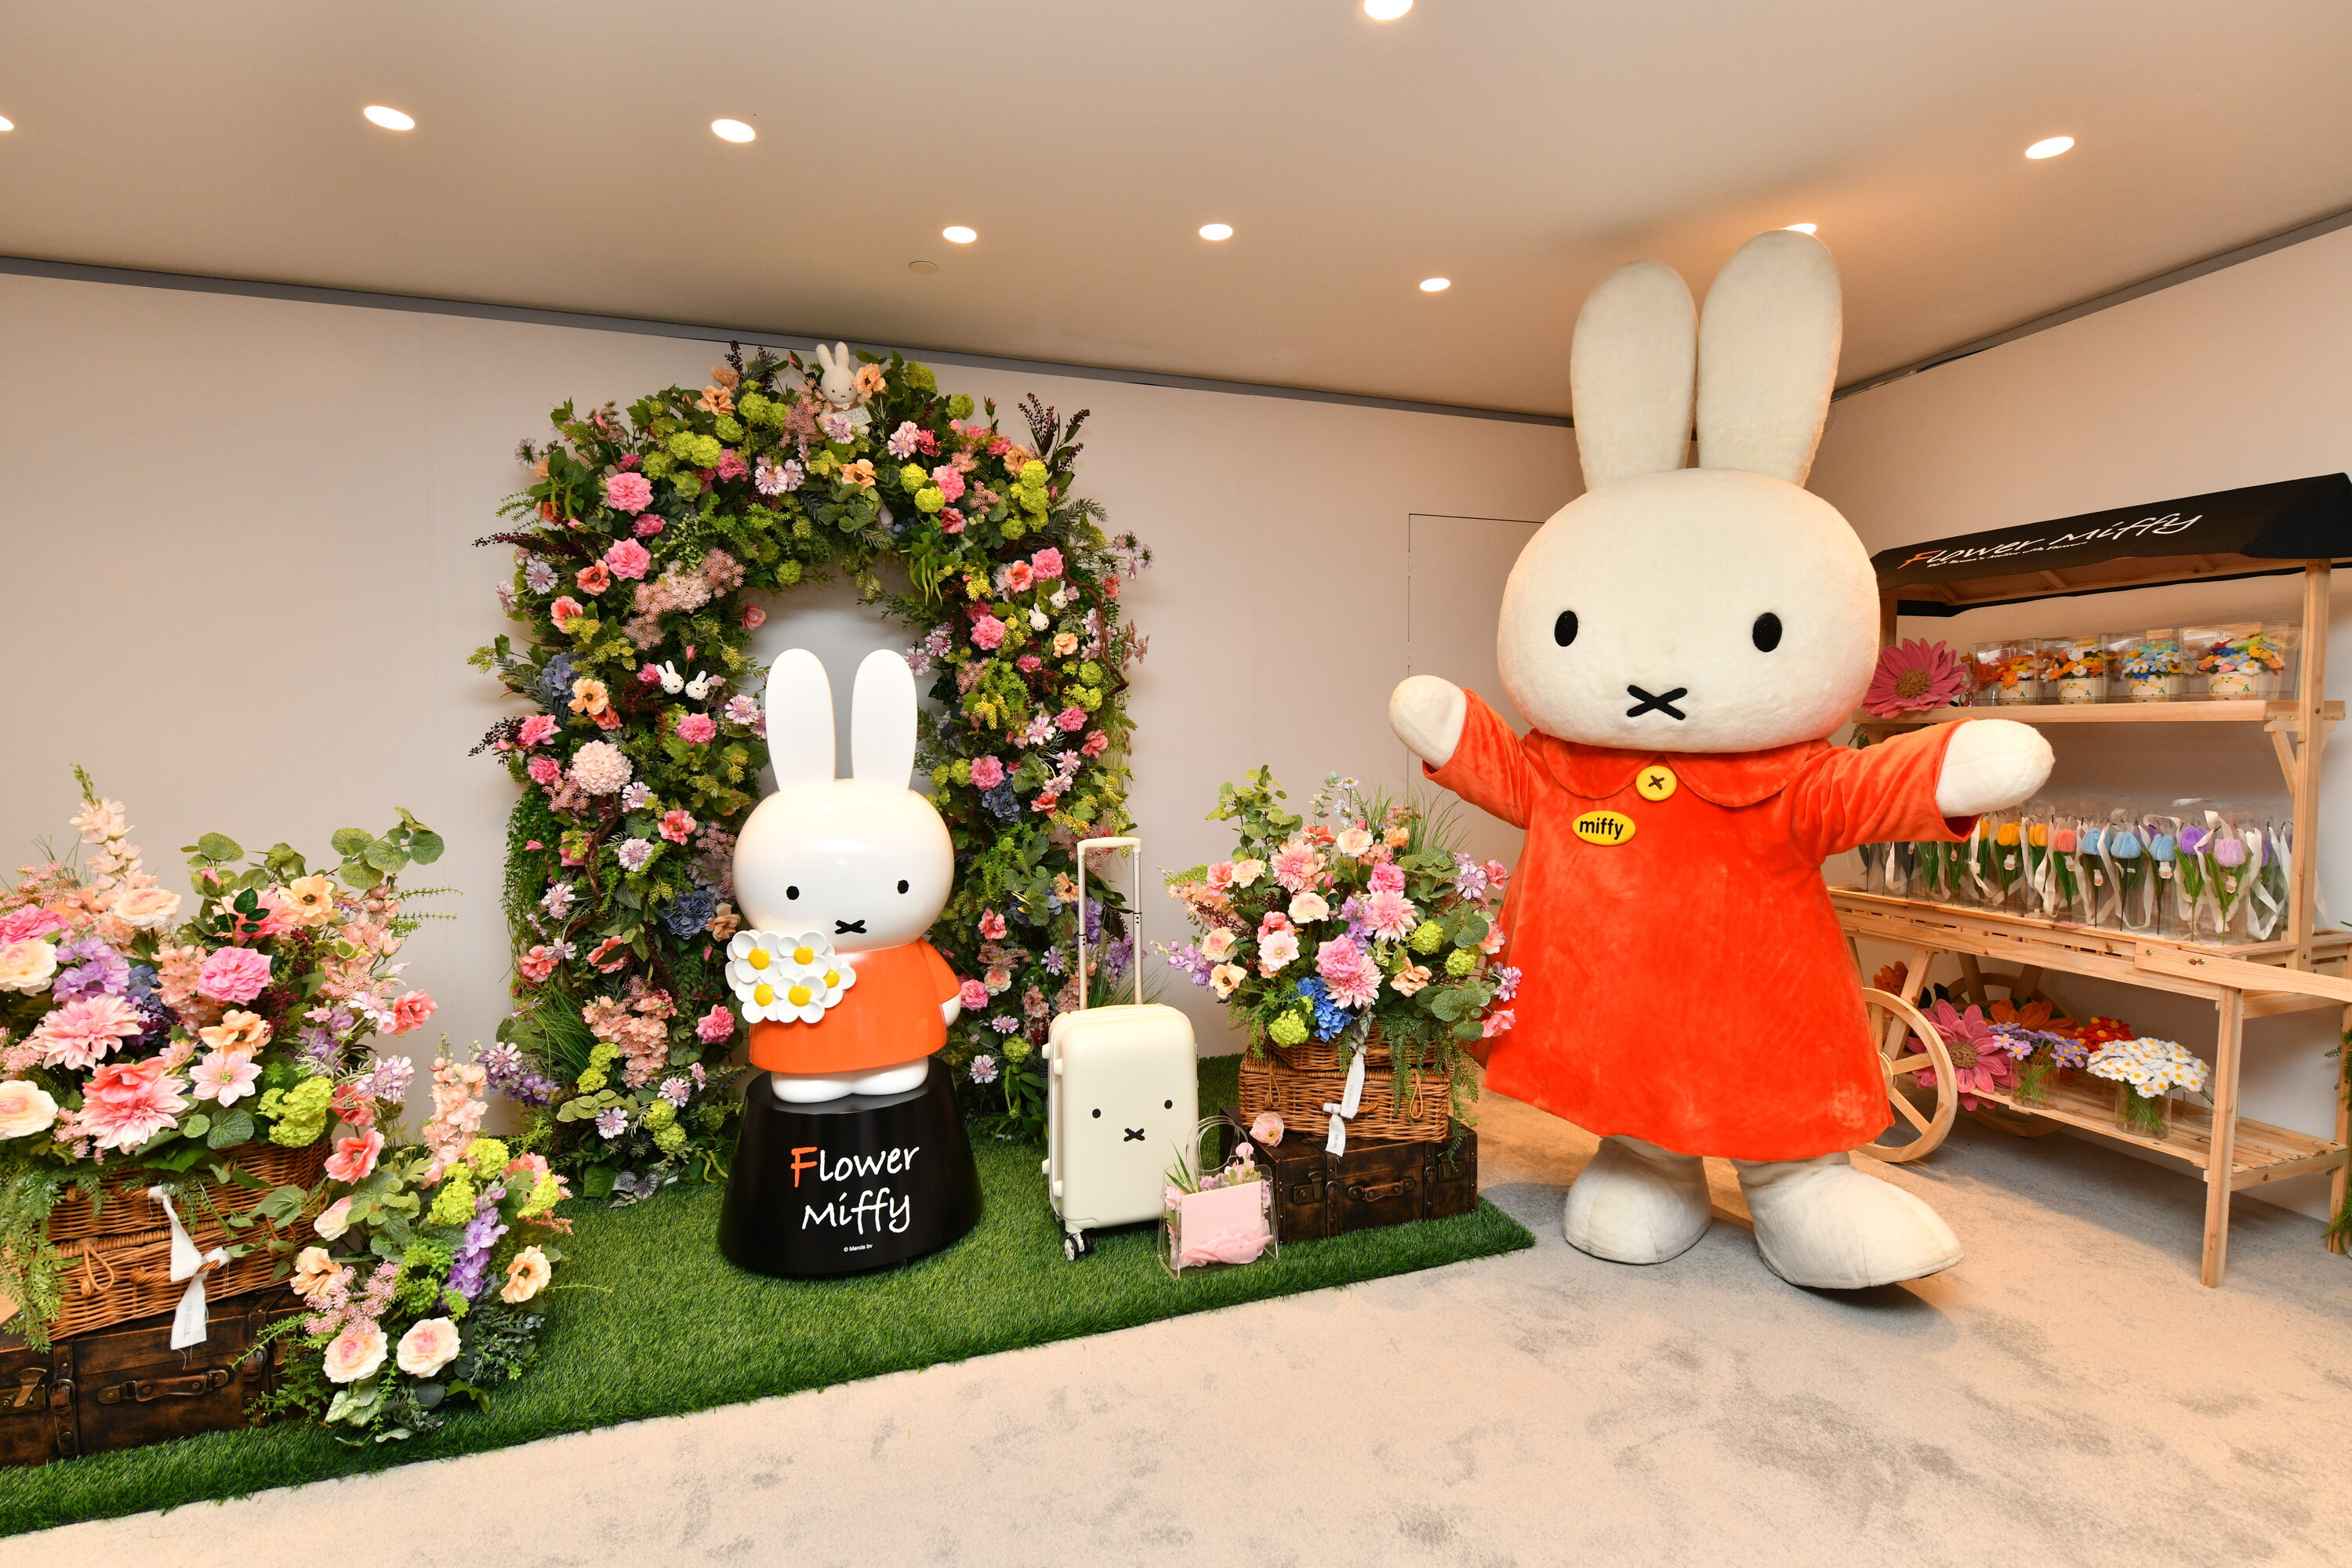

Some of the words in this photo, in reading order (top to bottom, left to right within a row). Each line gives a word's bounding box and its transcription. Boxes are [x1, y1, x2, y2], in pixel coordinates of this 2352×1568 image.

[1896, 539, 2045, 570] Flower
[2049, 513, 2203, 546] Miffy
[1579, 817, 1624, 840] miffy
[790, 1146, 920, 1188] Flower
[801, 1187, 910, 1235] Miffy
